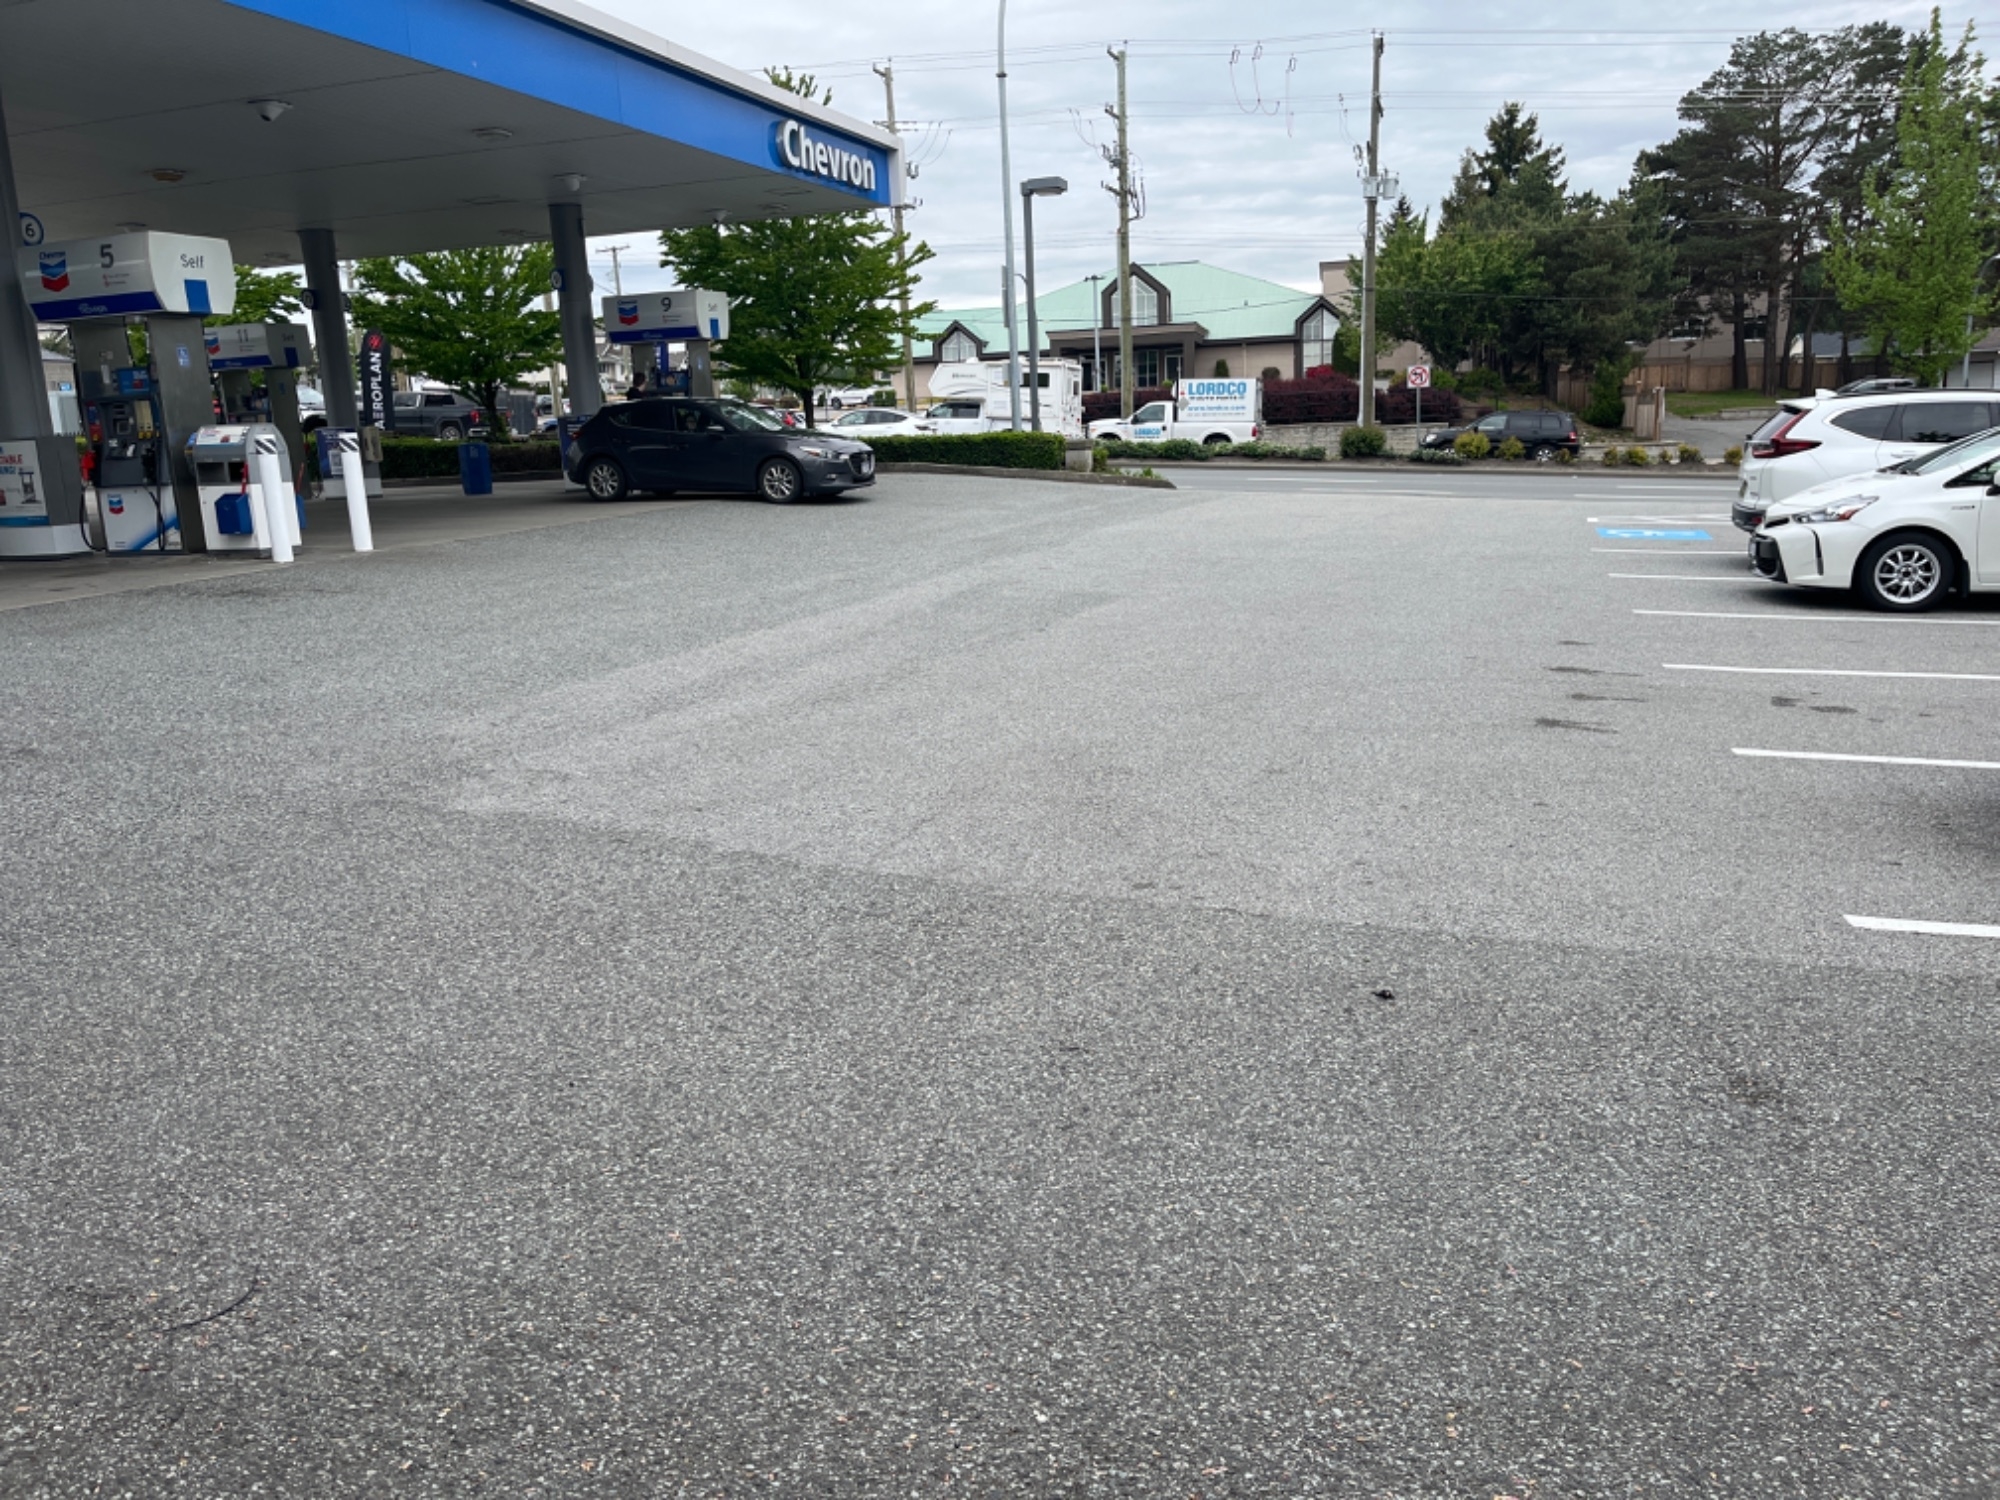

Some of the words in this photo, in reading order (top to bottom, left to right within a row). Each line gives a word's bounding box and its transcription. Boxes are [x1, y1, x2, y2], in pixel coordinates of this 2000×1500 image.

[782, 119, 876, 191] Chevron
[25, 223, 35, 238] 6
[100, 243, 114, 269] 5
[180, 253, 205, 269] Self
[660, 297, 672, 312] 9
[237, 328, 249, 343] 11
[369, 351, 386, 431] AEROPLAN
[1188, 382, 1247, 396] LORDCO
[1134, 428, 1161, 436] LORDCO
